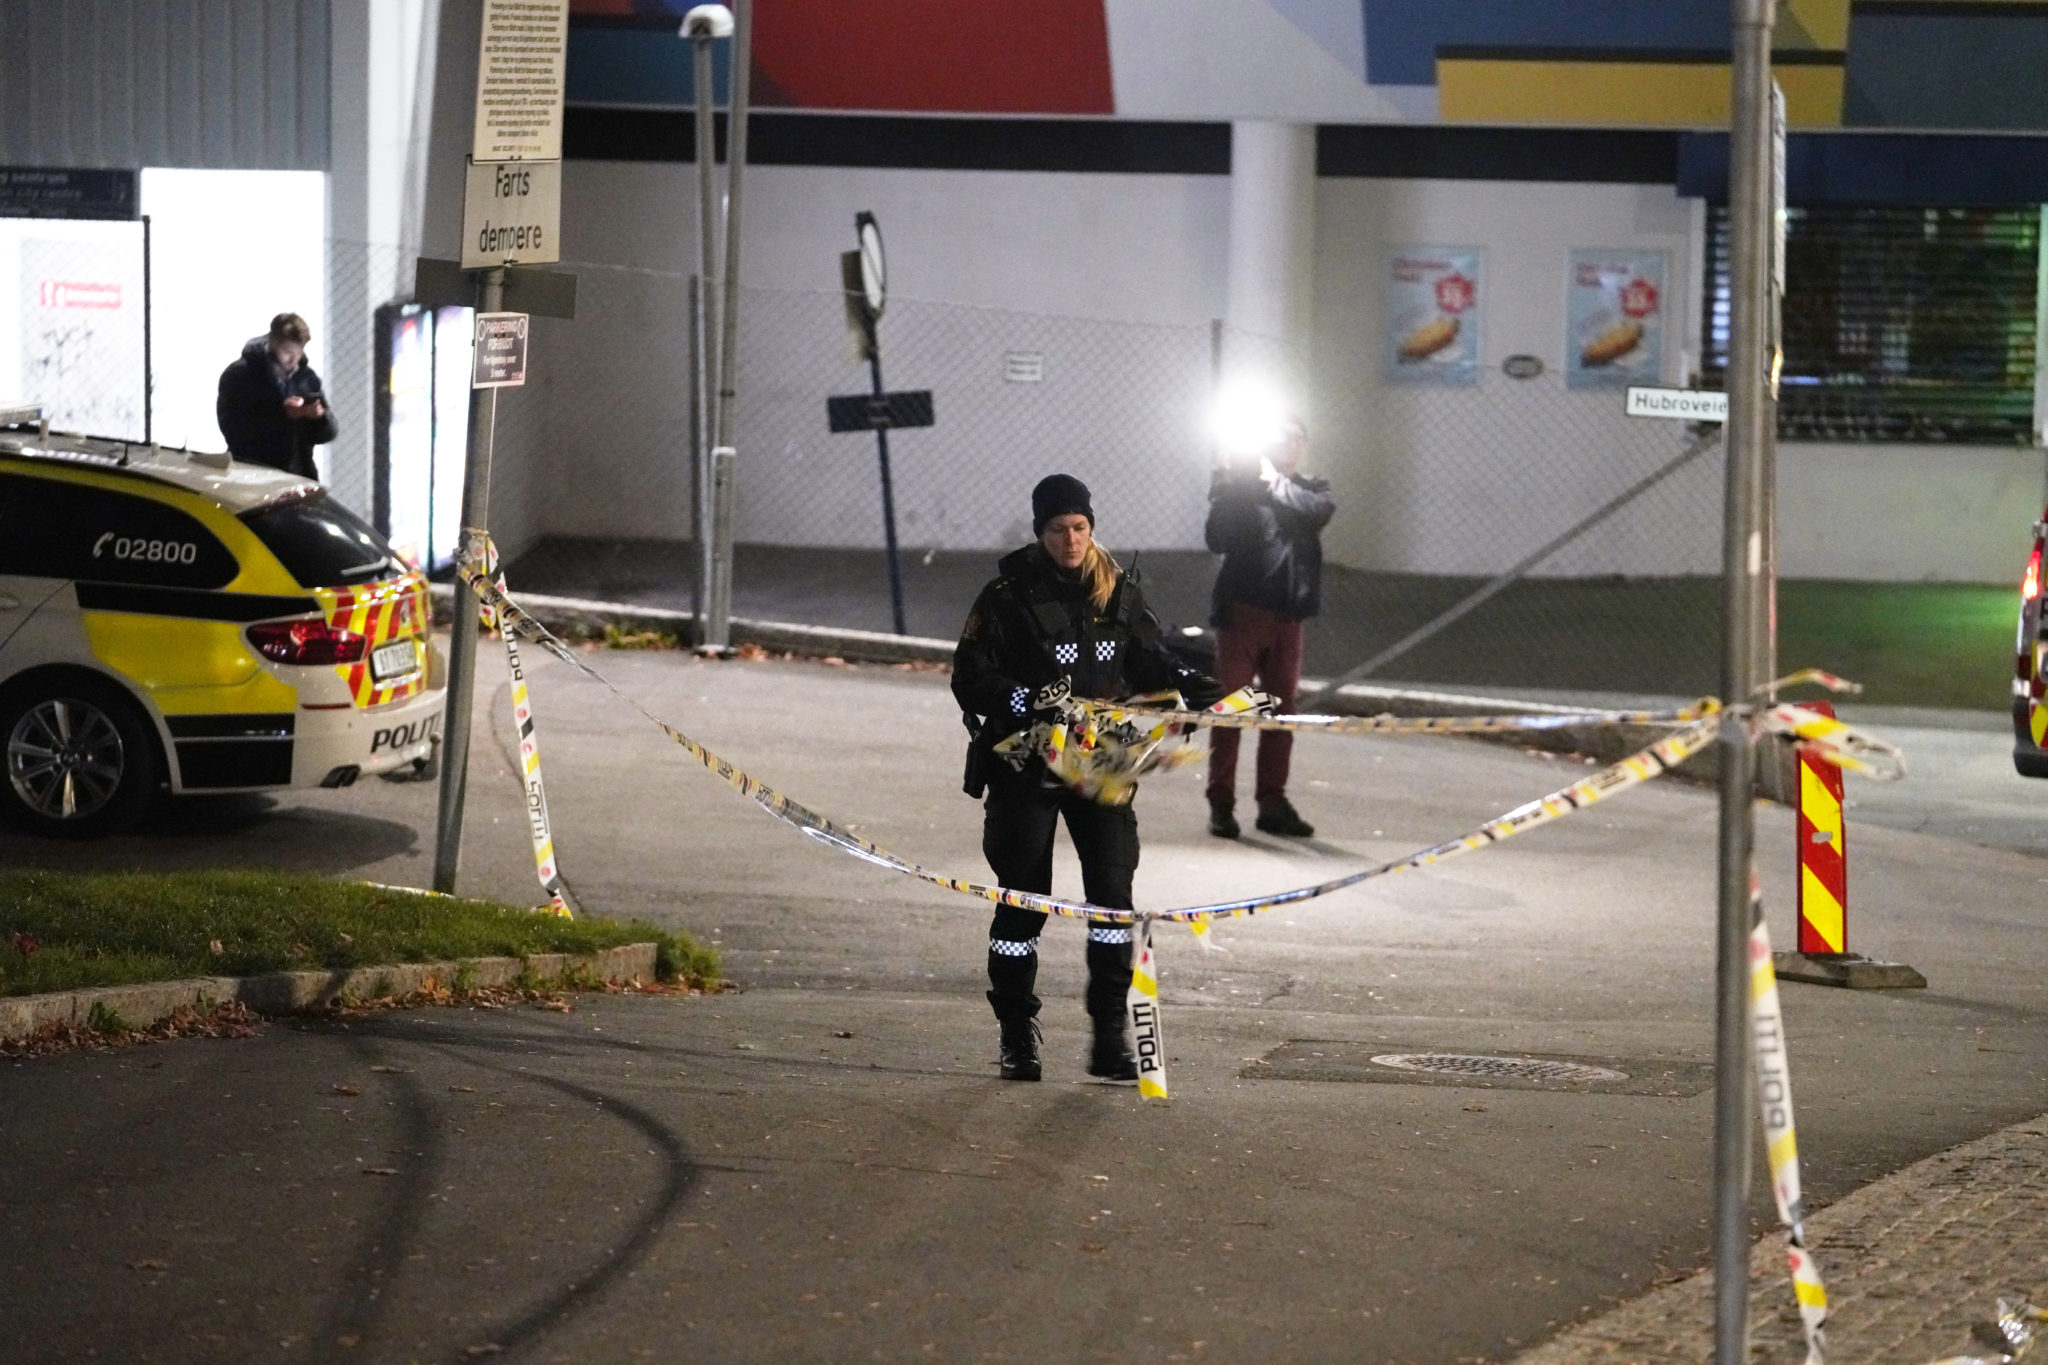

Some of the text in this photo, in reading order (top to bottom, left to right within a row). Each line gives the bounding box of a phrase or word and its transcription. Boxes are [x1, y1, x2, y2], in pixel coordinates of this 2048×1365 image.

[495, 165, 530, 197] Farts
[479, 219, 542, 257] dempere
[486, 320, 519, 333] PARKERING
[487, 337, 514, 350] FORBUDT
[114, 537, 197, 564] 02800
[1132, 1002, 1158, 1074] POLITI
